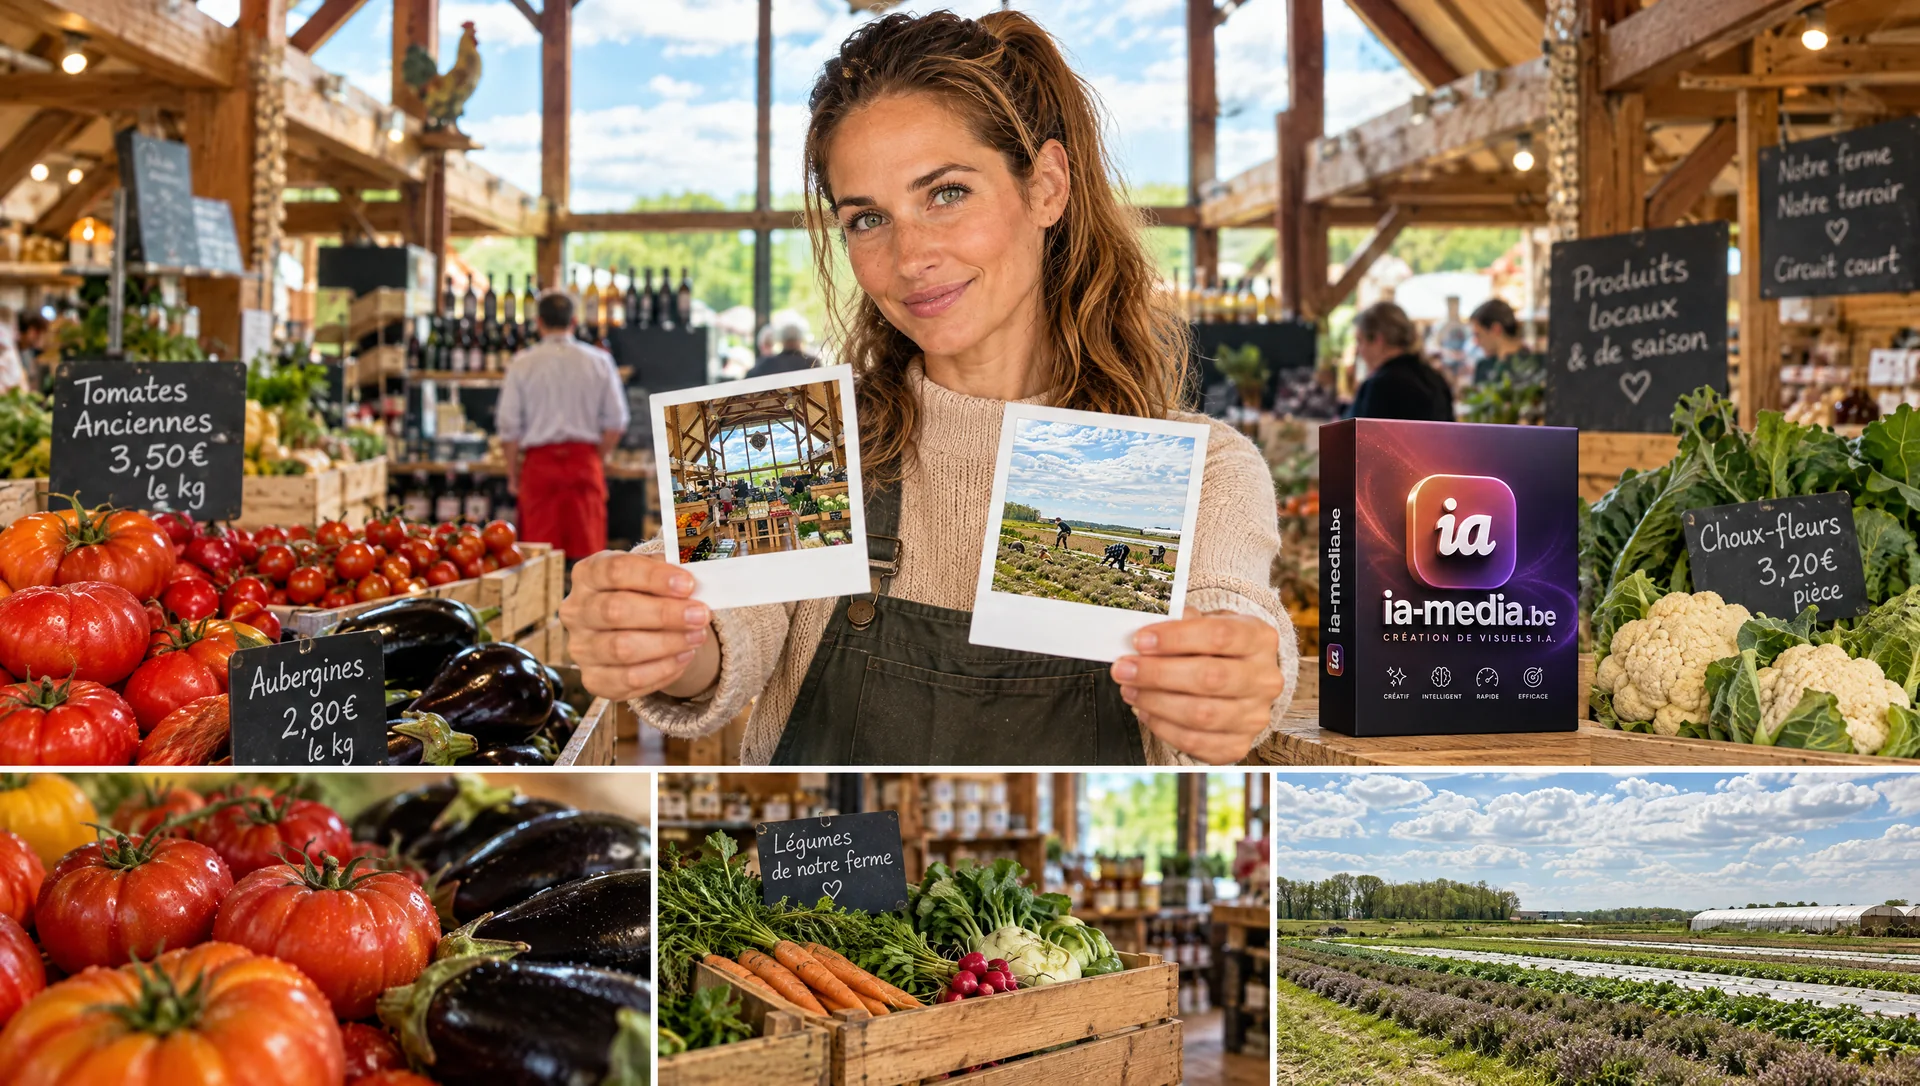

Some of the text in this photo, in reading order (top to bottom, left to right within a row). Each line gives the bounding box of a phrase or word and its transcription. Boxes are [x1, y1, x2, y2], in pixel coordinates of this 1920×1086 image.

[1778, 142, 1893, 184] Notre ferme
[1777, 178, 1904, 219] Notre terroir
[1572, 252, 1689, 302] Produits
[1774, 245, 1901, 283] Circuit court
[1588, 297, 1679, 332] locaux
[1567, 328, 1709, 372] & de saison
[73, 375, 188, 405] Tomates
[72, 409, 213, 439] Anciennes
[109, 441, 209, 478] 3,50€
[147, 473, 205, 510] le kg
[1435, 497, 1497, 556] ia
[1700, 512, 1841, 552] Choux-fleurs
[1328, 508, 1340, 633] ia-media.be
[1757, 548, 1837, 587] 3,20€
[1382, 589, 1557, 626] ia-media.be
[1793, 582, 1843, 614] pièce
[1383, 632, 1449, 642] CRÉATION
[1458, 634, 1472, 642] DE
[1480, 634, 1532, 642] VISUELS
[1329, 650, 1339, 669] ia
[249, 658, 364, 700] Aubergines
[1383, 692, 1409, 700] CRÉATIF
[282, 694, 358, 740] 2,80€
[308, 732, 354, 766] le kg
[774, 832, 852, 860] Légumes
[772, 850, 893, 880] de notre ferme
